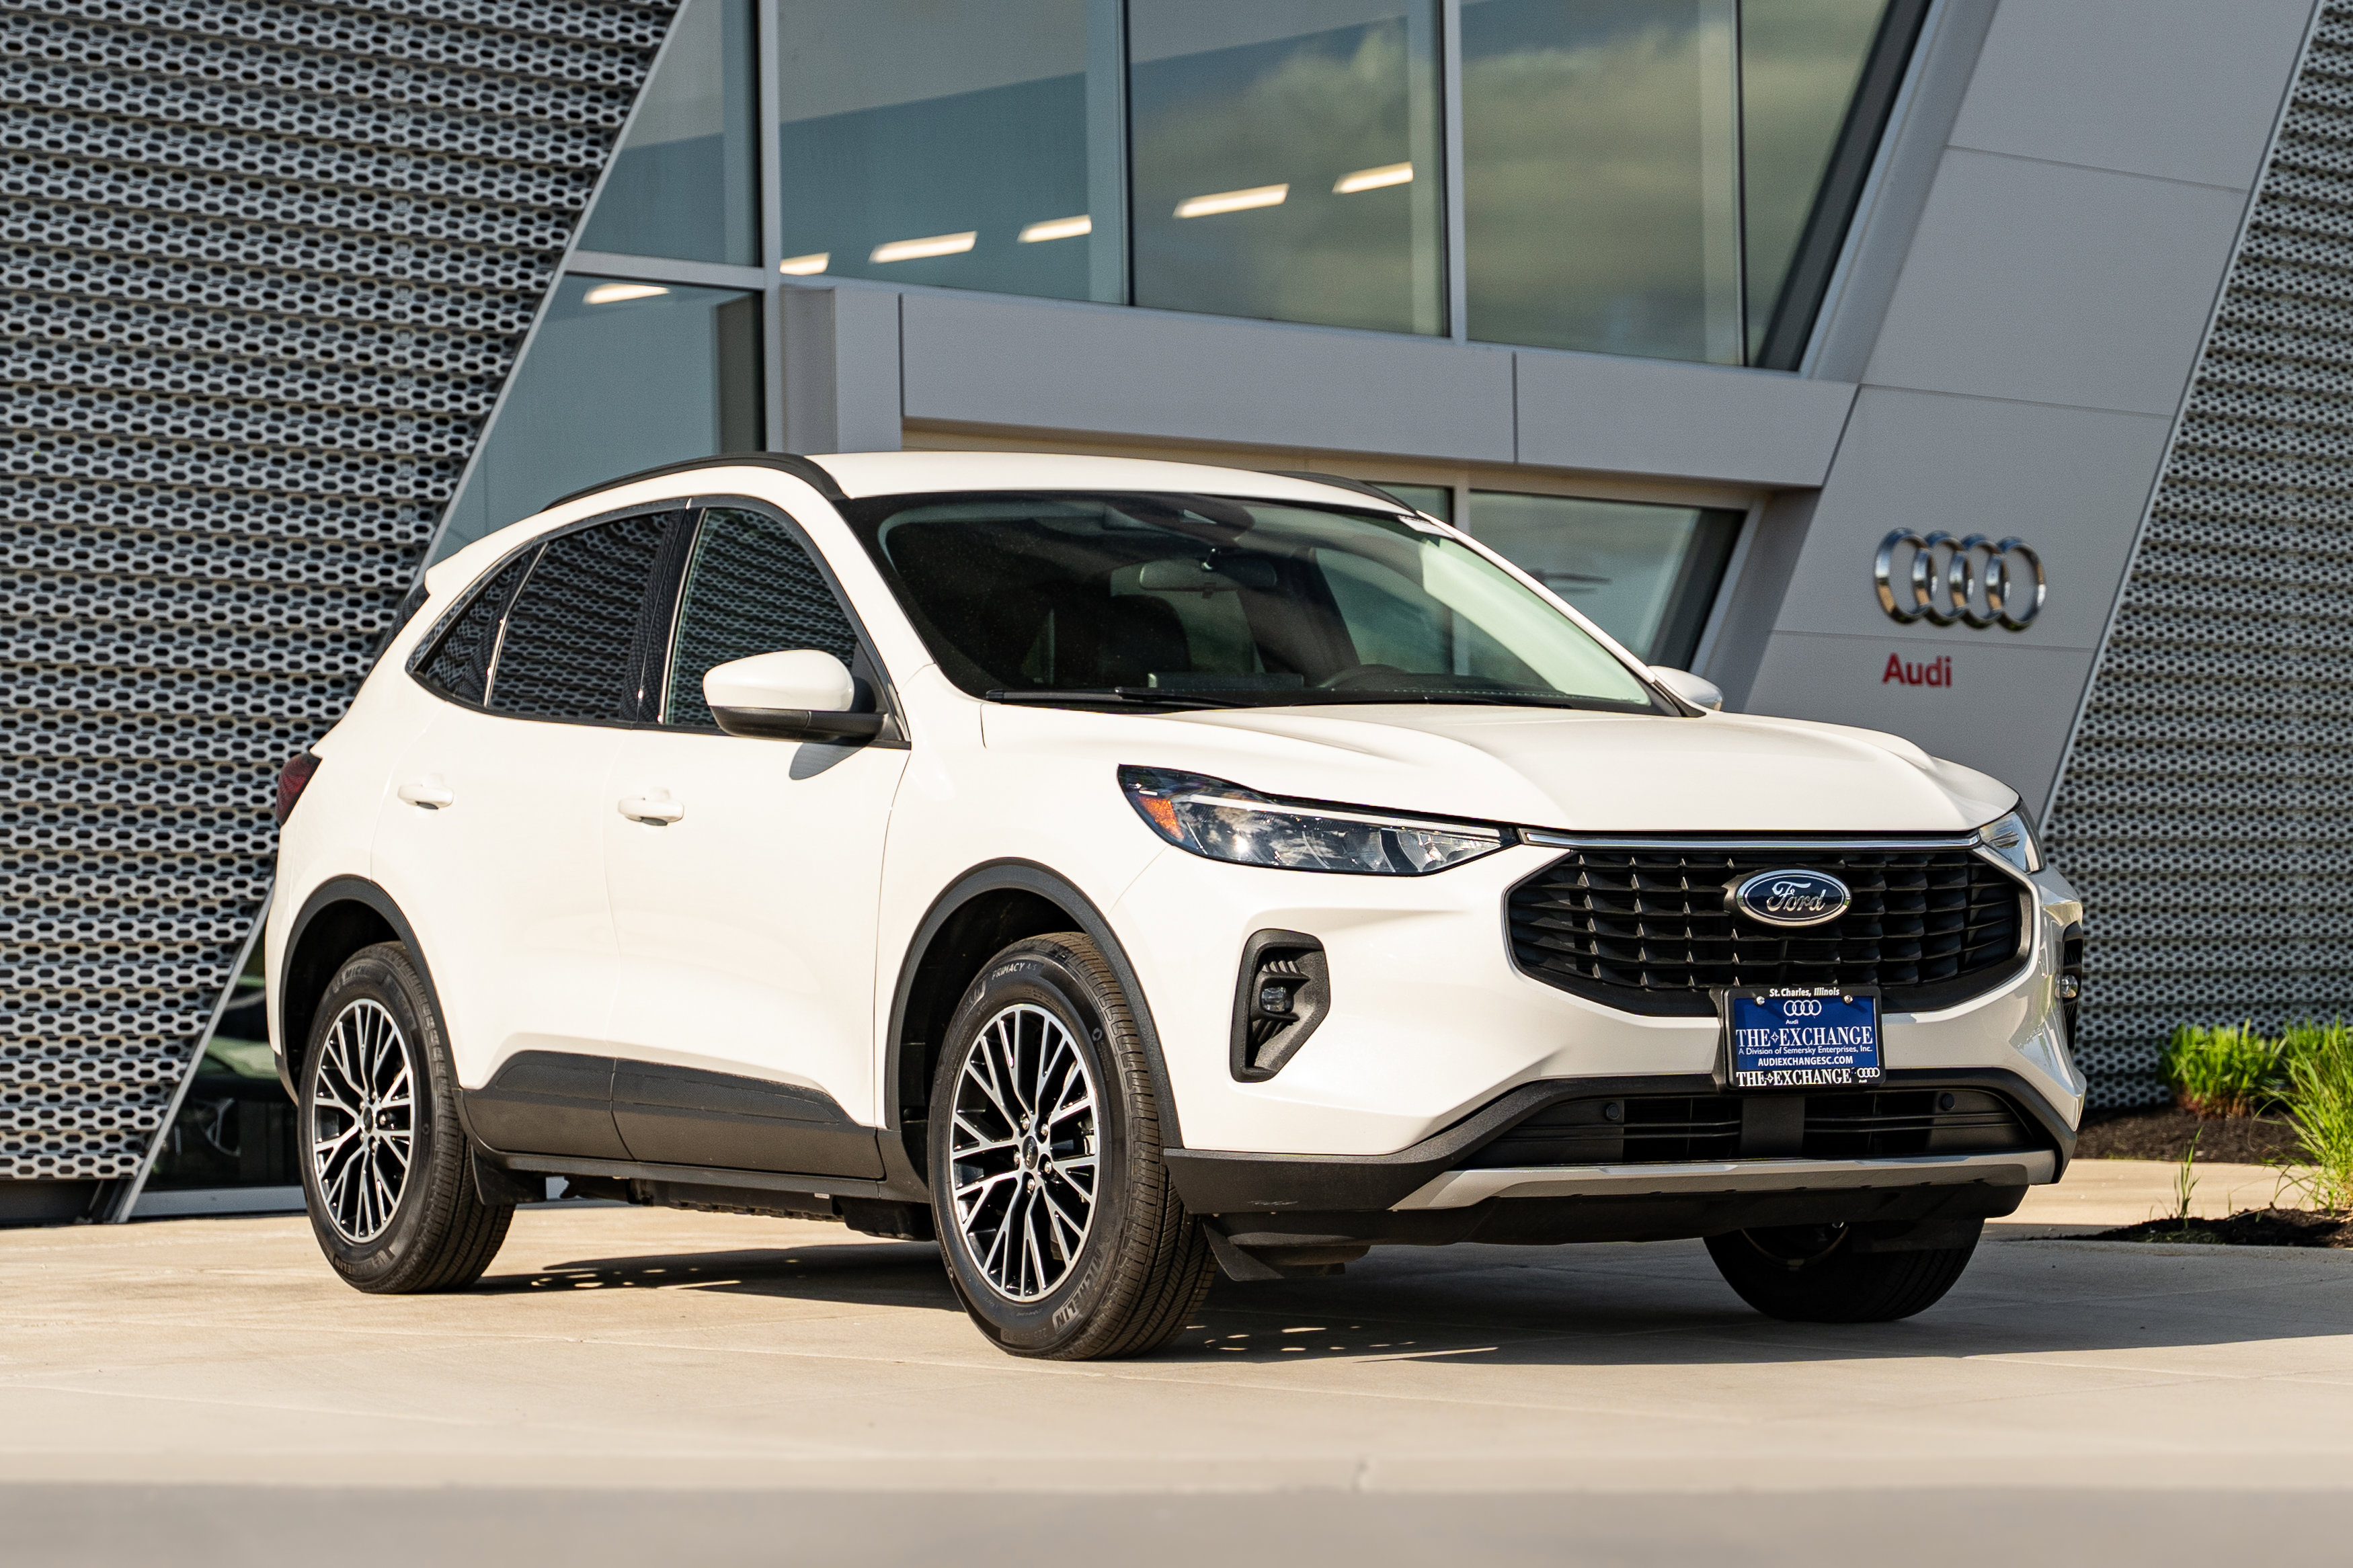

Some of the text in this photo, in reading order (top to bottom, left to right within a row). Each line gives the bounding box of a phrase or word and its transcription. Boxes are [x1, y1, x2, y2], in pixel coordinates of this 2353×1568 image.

[1882, 653, 1953, 688] Audi
[1766, 880, 1827, 912] Ford
[992, 962, 1025, 981] PRIMACY
[1769, 987, 1840, 997] St. Charles, Illinois
[1736, 1026, 1873, 1047] THE EXCHANGE
[1746, 1047, 1773, 1055] Division
[1783, 1046, 1817, 1055] Semersky
[1818, 1045, 1859, 1055] Enterprises,
[1757, 1055, 1853, 1067] AUDIEXCHANGESC.COM
[1736, 1067, 1852, 1087] THE EXCHANGE
